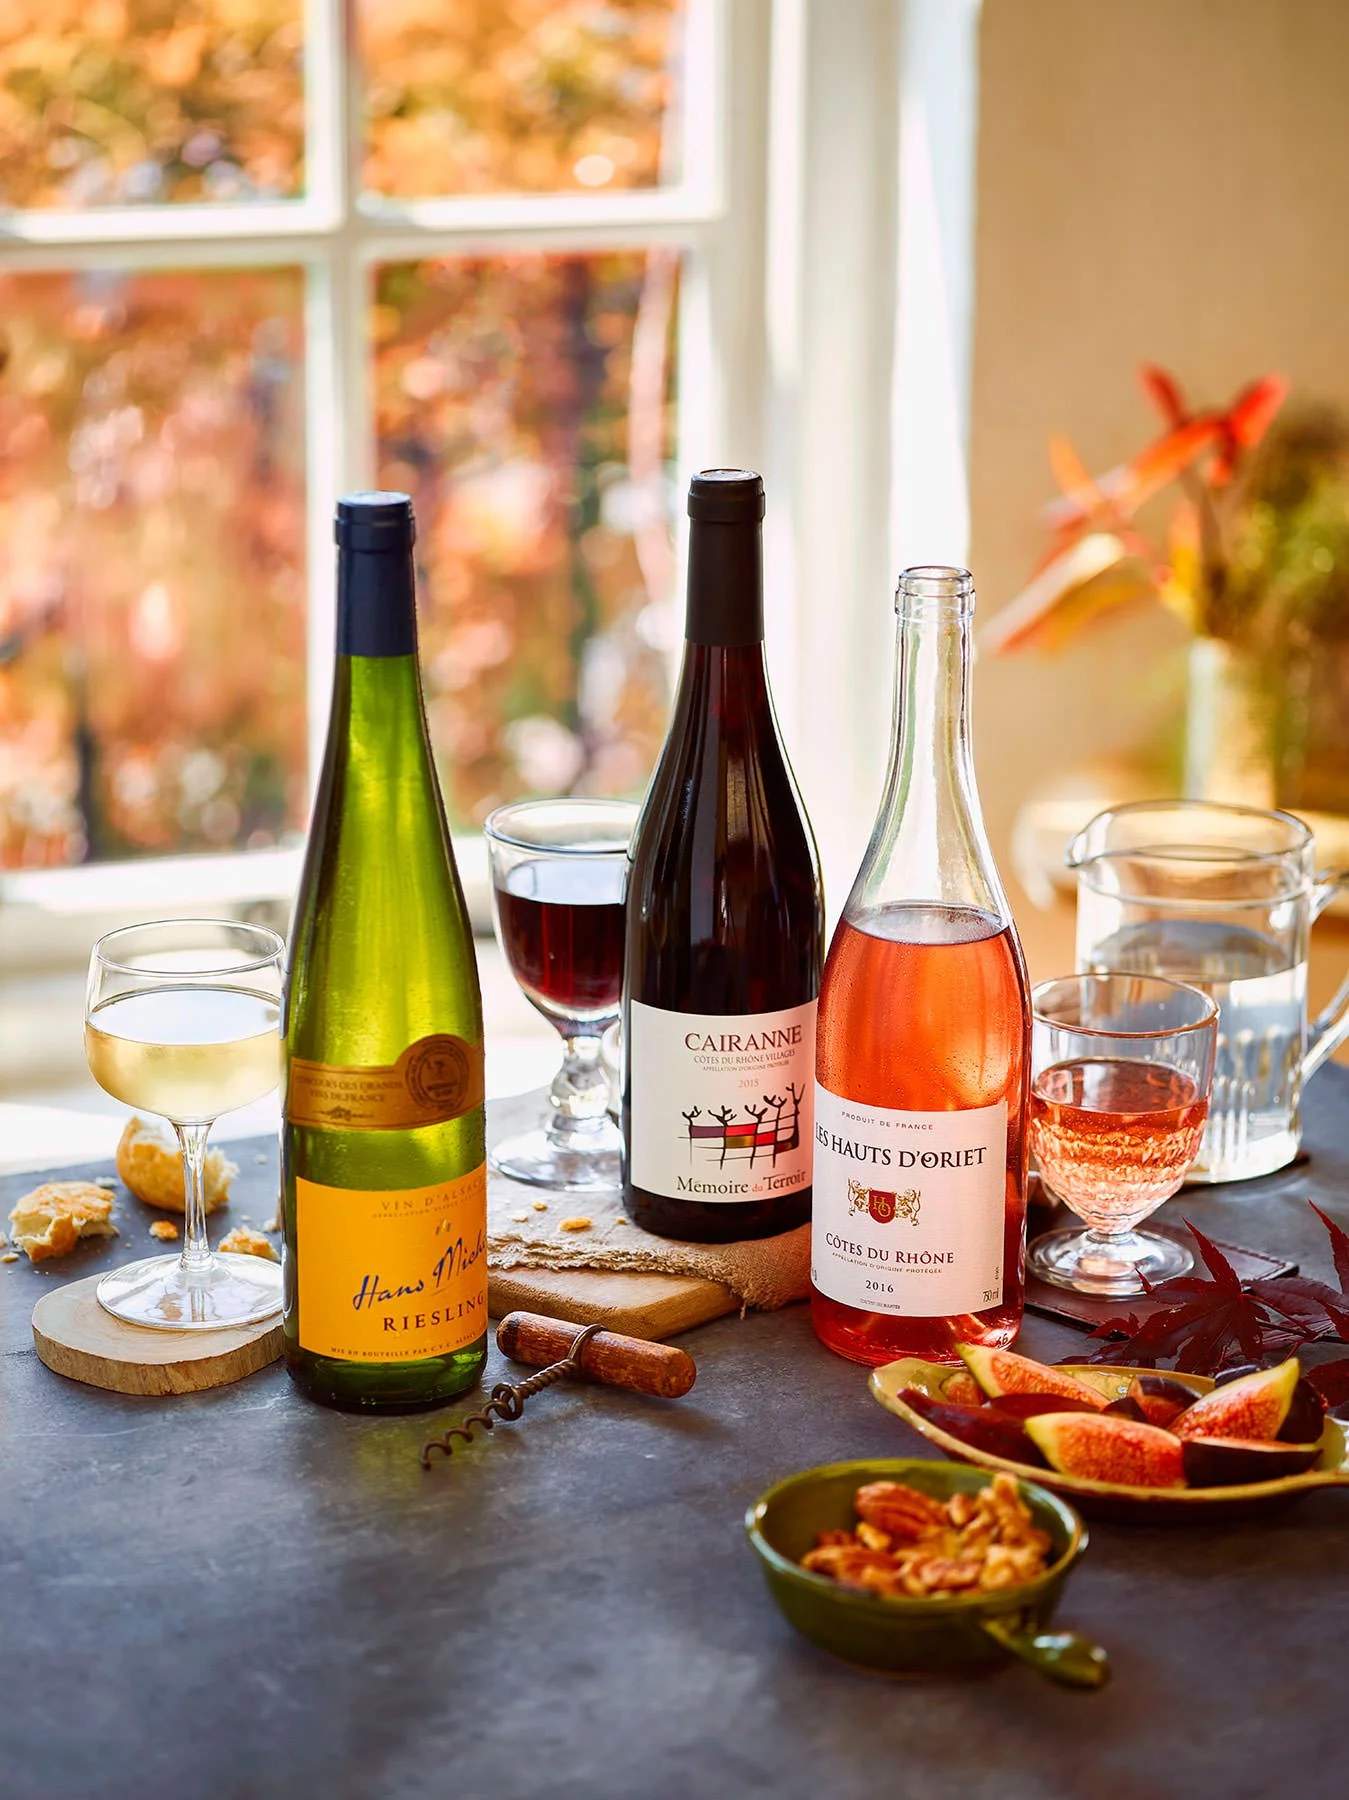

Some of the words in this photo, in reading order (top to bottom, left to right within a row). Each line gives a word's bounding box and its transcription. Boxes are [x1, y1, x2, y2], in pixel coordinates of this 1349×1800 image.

[684, 1024, 802, 1052] CAIRANNE
[693, 1054, 720, 1065] CÔTES
[721, 1056, 734, 1065] DU
[735, 1053, 765, 1065] RHÔNE
[766, 1048, 796, 1061] VILLAGES
[738, 1078, 760, 1088] 2015
[841, 1111, 875, 1125] PRODUIT
[879, 1120, 892, 1128] DE
[895, 1122, 934, 1130] FRANCE
[815, 1121, 829, 1147] LES
[831, 1134, 892, 1166] HAUTS
[898, 1147, 988, 1168] D'ORIET
[751, 1183, 763, 1192] du
[763, 1169, 806, 1191] Terroir
[382, 1201, 413, 1211] VIN
[825, 1232, 863, 1256] CÔTES
[867, 1247, 889, 1261] DU
[895, 1250, 954, 1264] RHÔNE
[832, 1252, 868, 1268] APPELLATION
[352, 1274, 425, 1310] Hans
[865, 1279, 894, 1293] 2016
[383, 1291, 485, 1332] RIESLING
